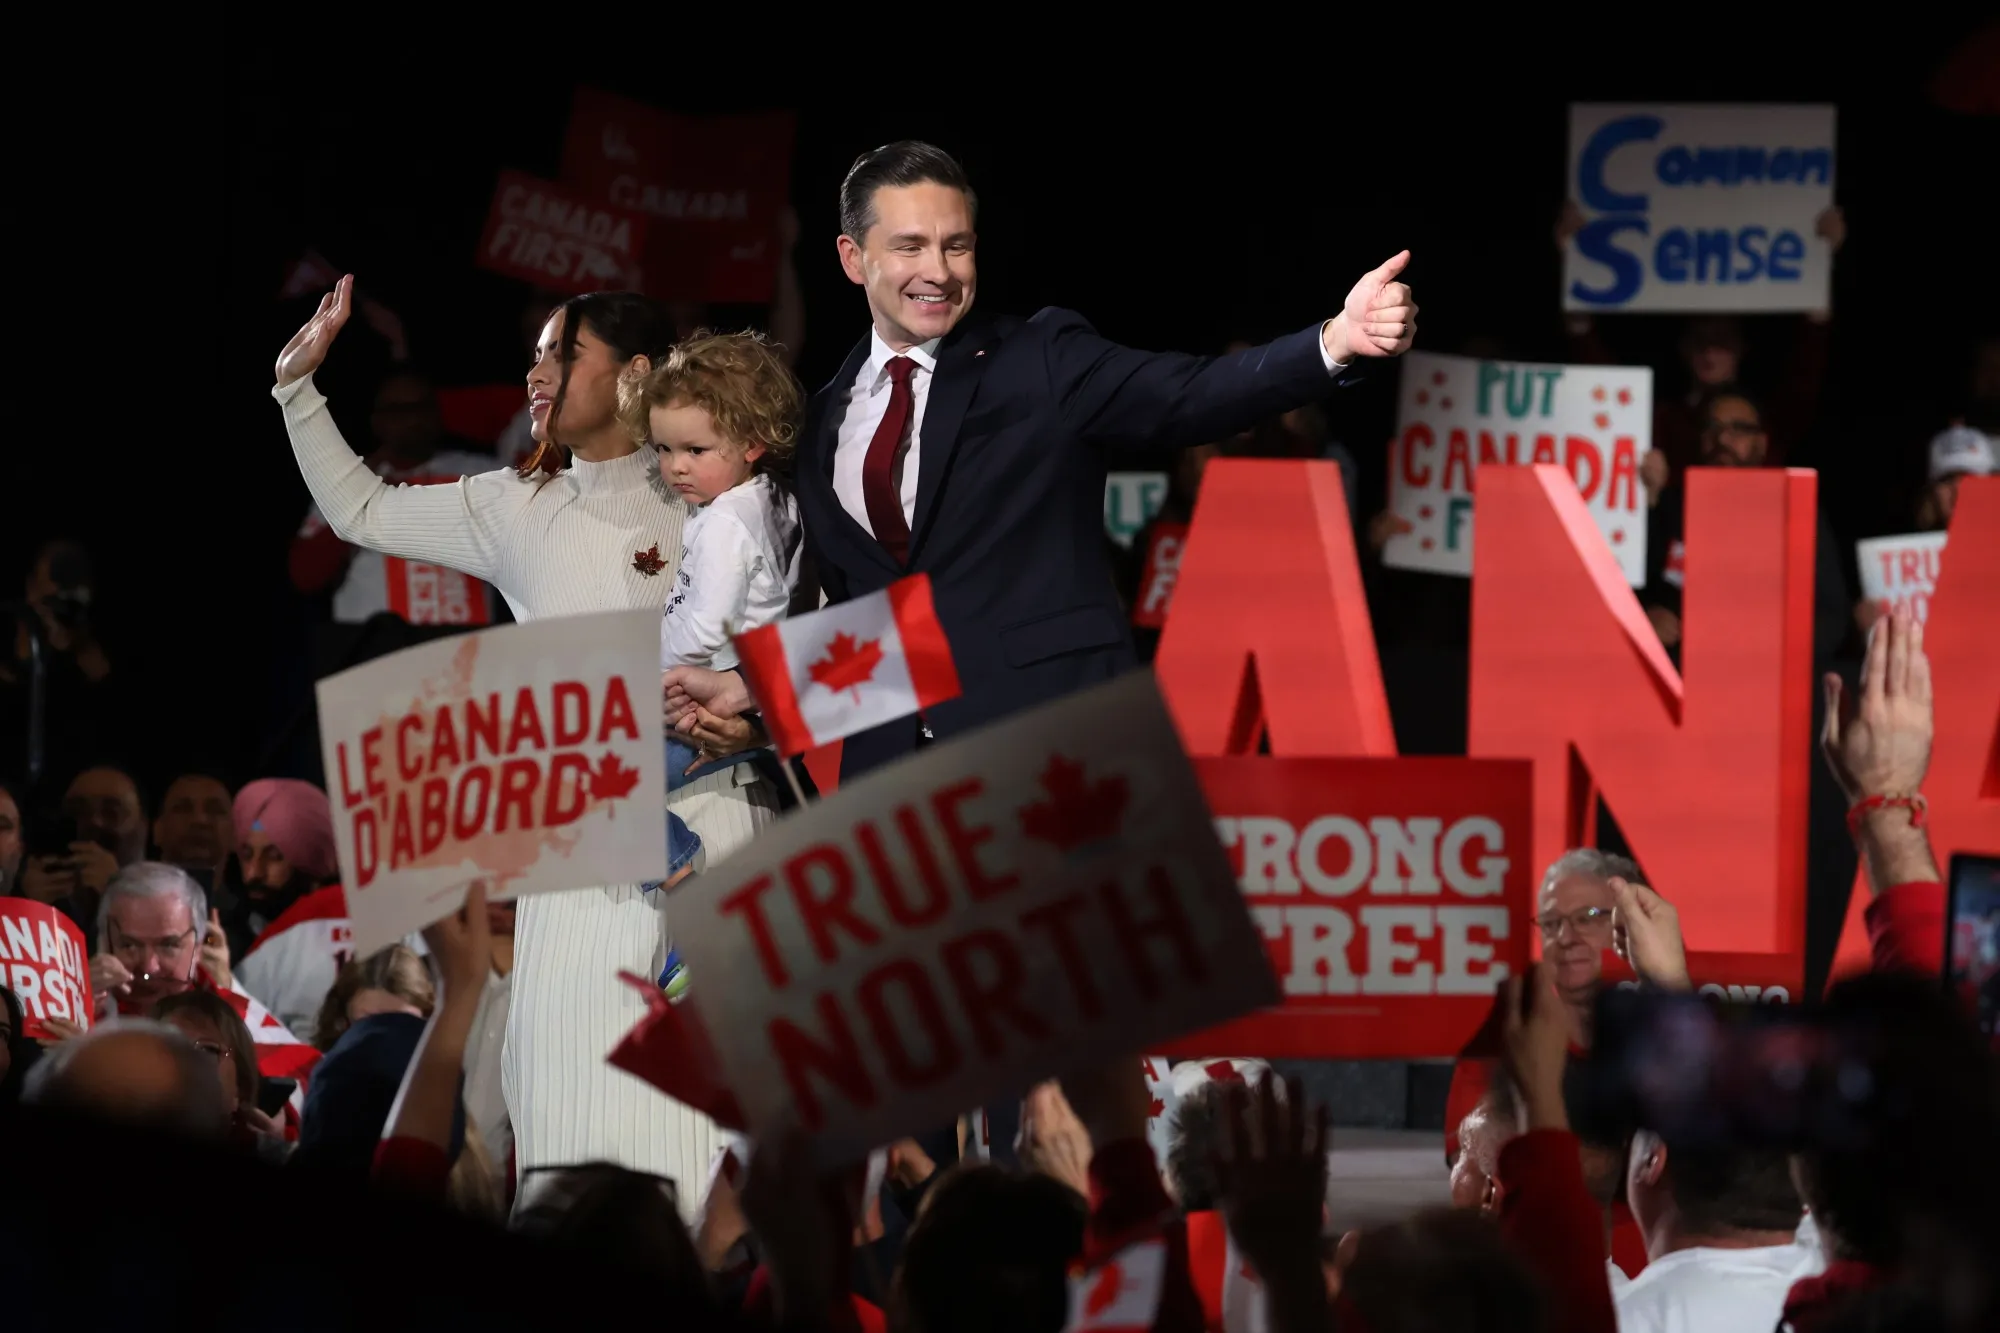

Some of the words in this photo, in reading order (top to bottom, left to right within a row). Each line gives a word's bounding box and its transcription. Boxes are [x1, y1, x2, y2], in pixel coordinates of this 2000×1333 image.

[488, 222, 610, 284] FIRST
[500, 184, 632, 252] CANADA
[1570, 215, 1805, 305] Sense
[1474, 361, 1563, 417] PUT
[1878, 548, 1941, 588] TRU
[337, 725, 386, 808] LE
[395, 675, 640, 782] CANADA
[353, 752, 590, 888] D'ABORD
[1212, 814, 1512, 897] RONG
[717, 775, 1020, 989] TRUE
[0, 914, 87, 995] NADA
[0, 962, 82, 1030] RST
[767, 864, 1211, 1132] NORTH
